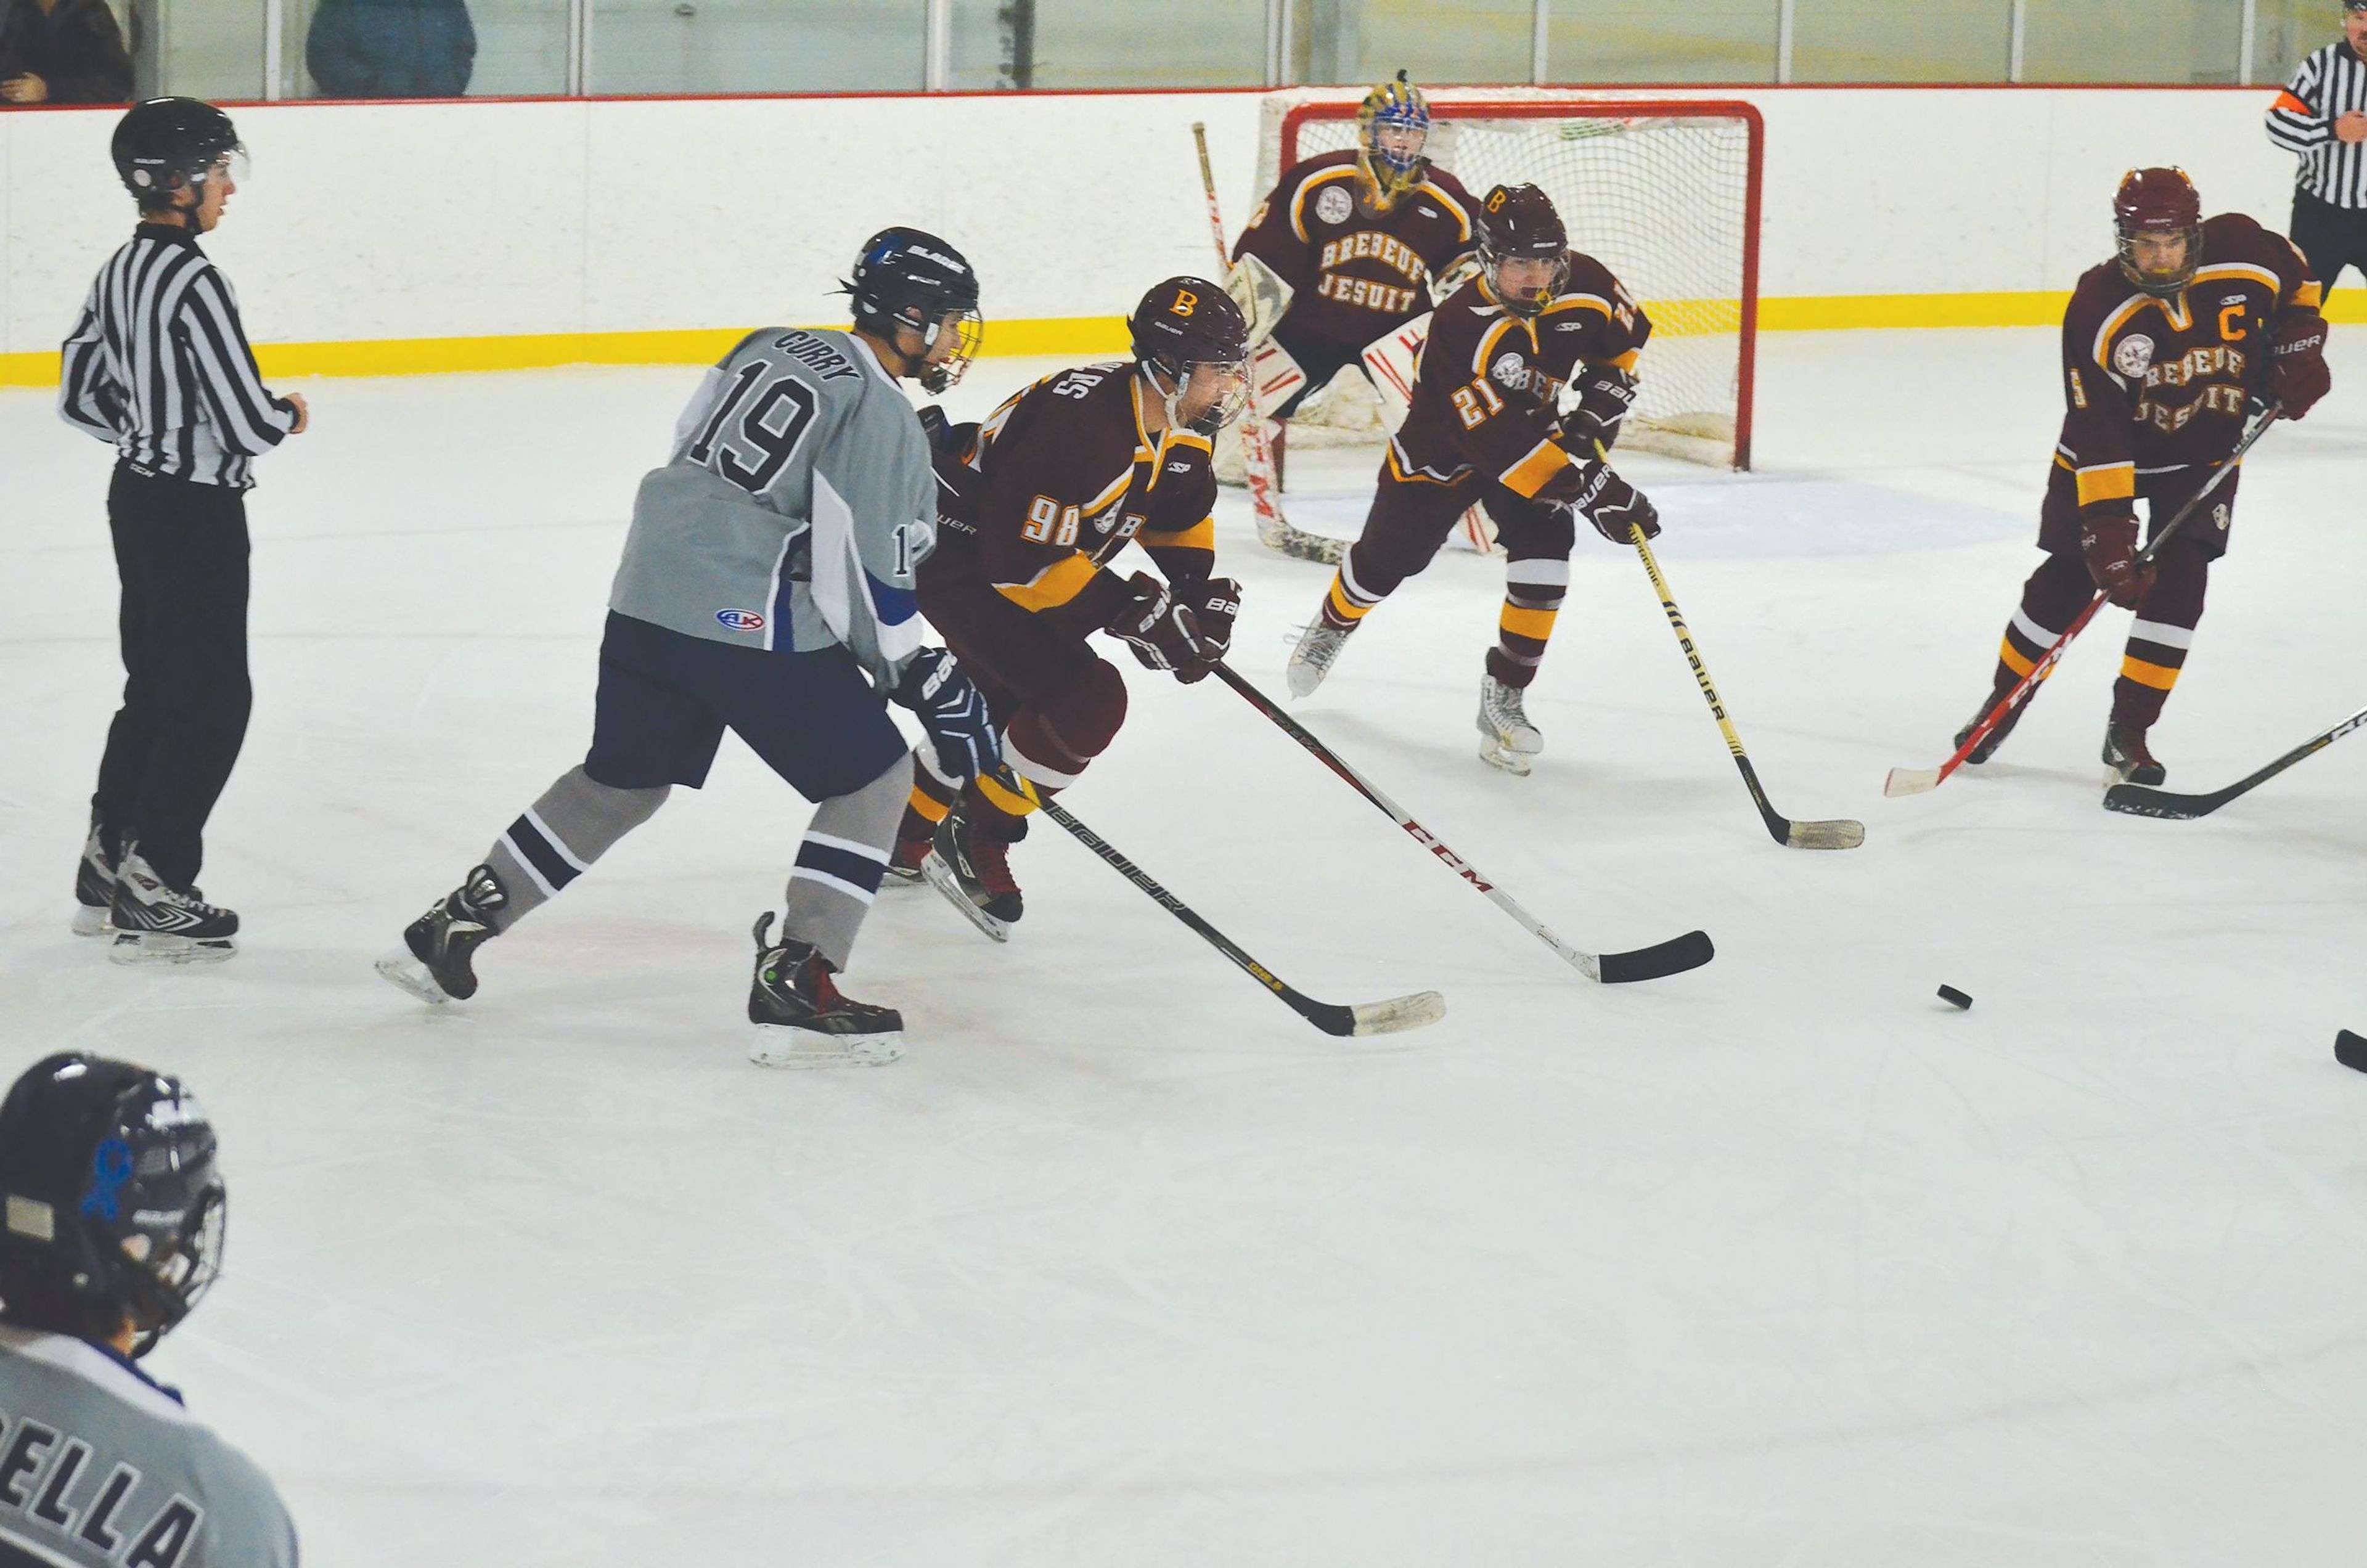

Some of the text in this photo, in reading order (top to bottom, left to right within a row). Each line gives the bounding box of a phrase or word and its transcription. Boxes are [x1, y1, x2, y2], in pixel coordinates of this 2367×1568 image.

[1487, 190, 1507, 214] B
[1319, 229, 1426, 285] BREBEUF
[1169, 289, 1198, 317] B
[1317, 272, 1417, 312] JESUIT
[2219, 305, 2247, 341] C
[772, 329, 864, 382] CURRY
[685, 358, 820, 496] 19
[1450, 375, 1506, 430] 21
[2133, 384, 2245, 433] JESIT
[1020, 494, 1079, 547] 98
[1401, 819, 1494, 892] CCM
